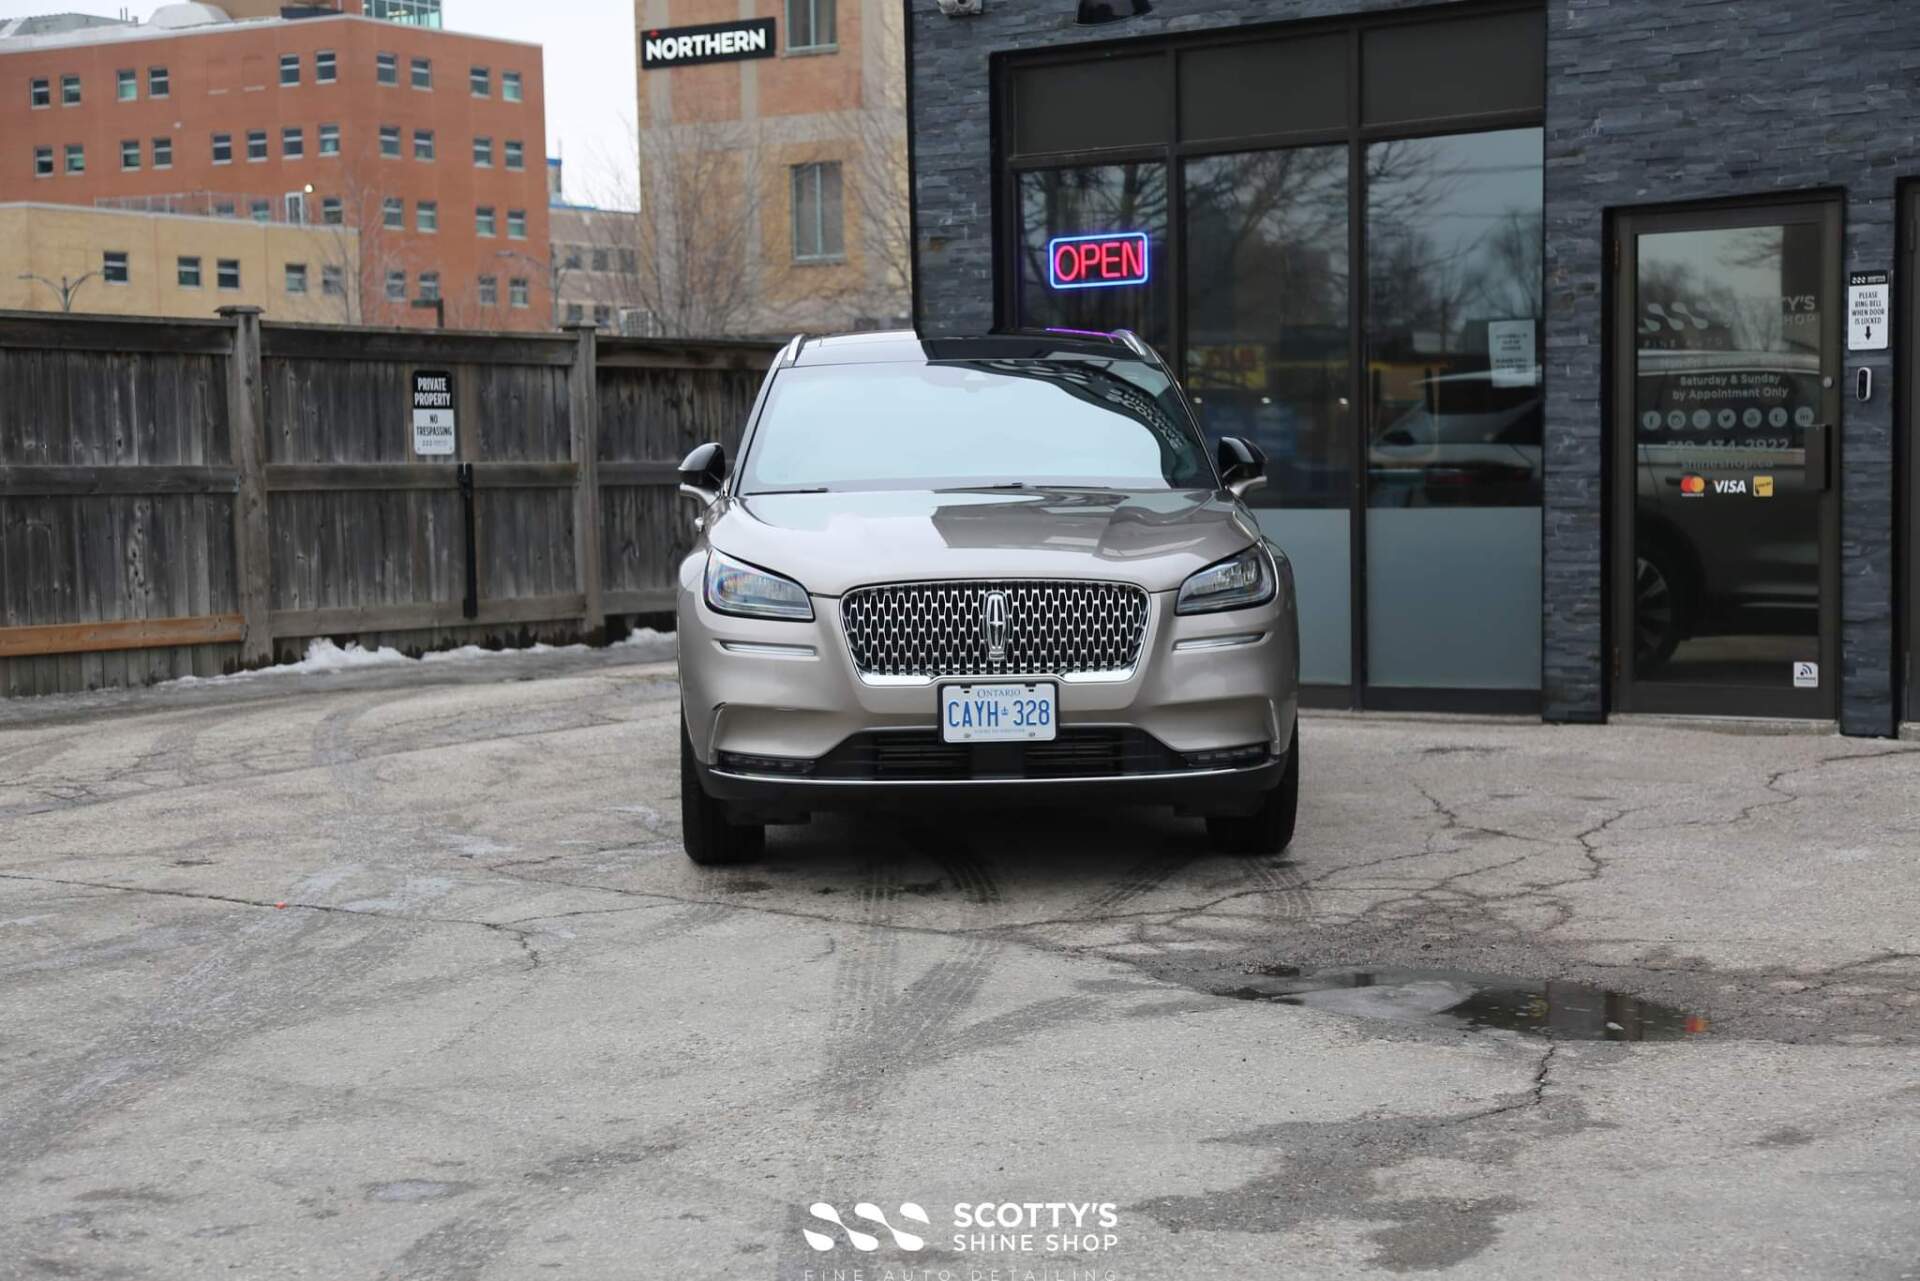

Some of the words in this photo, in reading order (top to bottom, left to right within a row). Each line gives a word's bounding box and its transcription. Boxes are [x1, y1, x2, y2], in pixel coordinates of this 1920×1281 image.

[645, 28, 766, 61] NORTHERN
[1055, 240, 1143, 281] OPEN
[1859, 291, 1878, 299] PLEASE
[417, 377, 447, 391] PRIVATE
[1680, 375, 1727, 387] Saturday
[1730, 375, 1738, 385] &
[1741, 374, 1780, 386] Sunday
[414, 392, 451, 406] PROPERTY
[1672, 388, 1686, 401] by
[1688, 388, 1760, 400] Appointment
[1762, 386, 1789, 399] Only
[429, 414, 438, 424] NO
[416, 426, 452, 436] TRESPASSING
[1714, 480, 1747, 493] VISA
[977, 688, 1020, 698] ONTARIO
[948, 701, 999, 727] CAYH
[1013, 700, 1050, 726] 328
